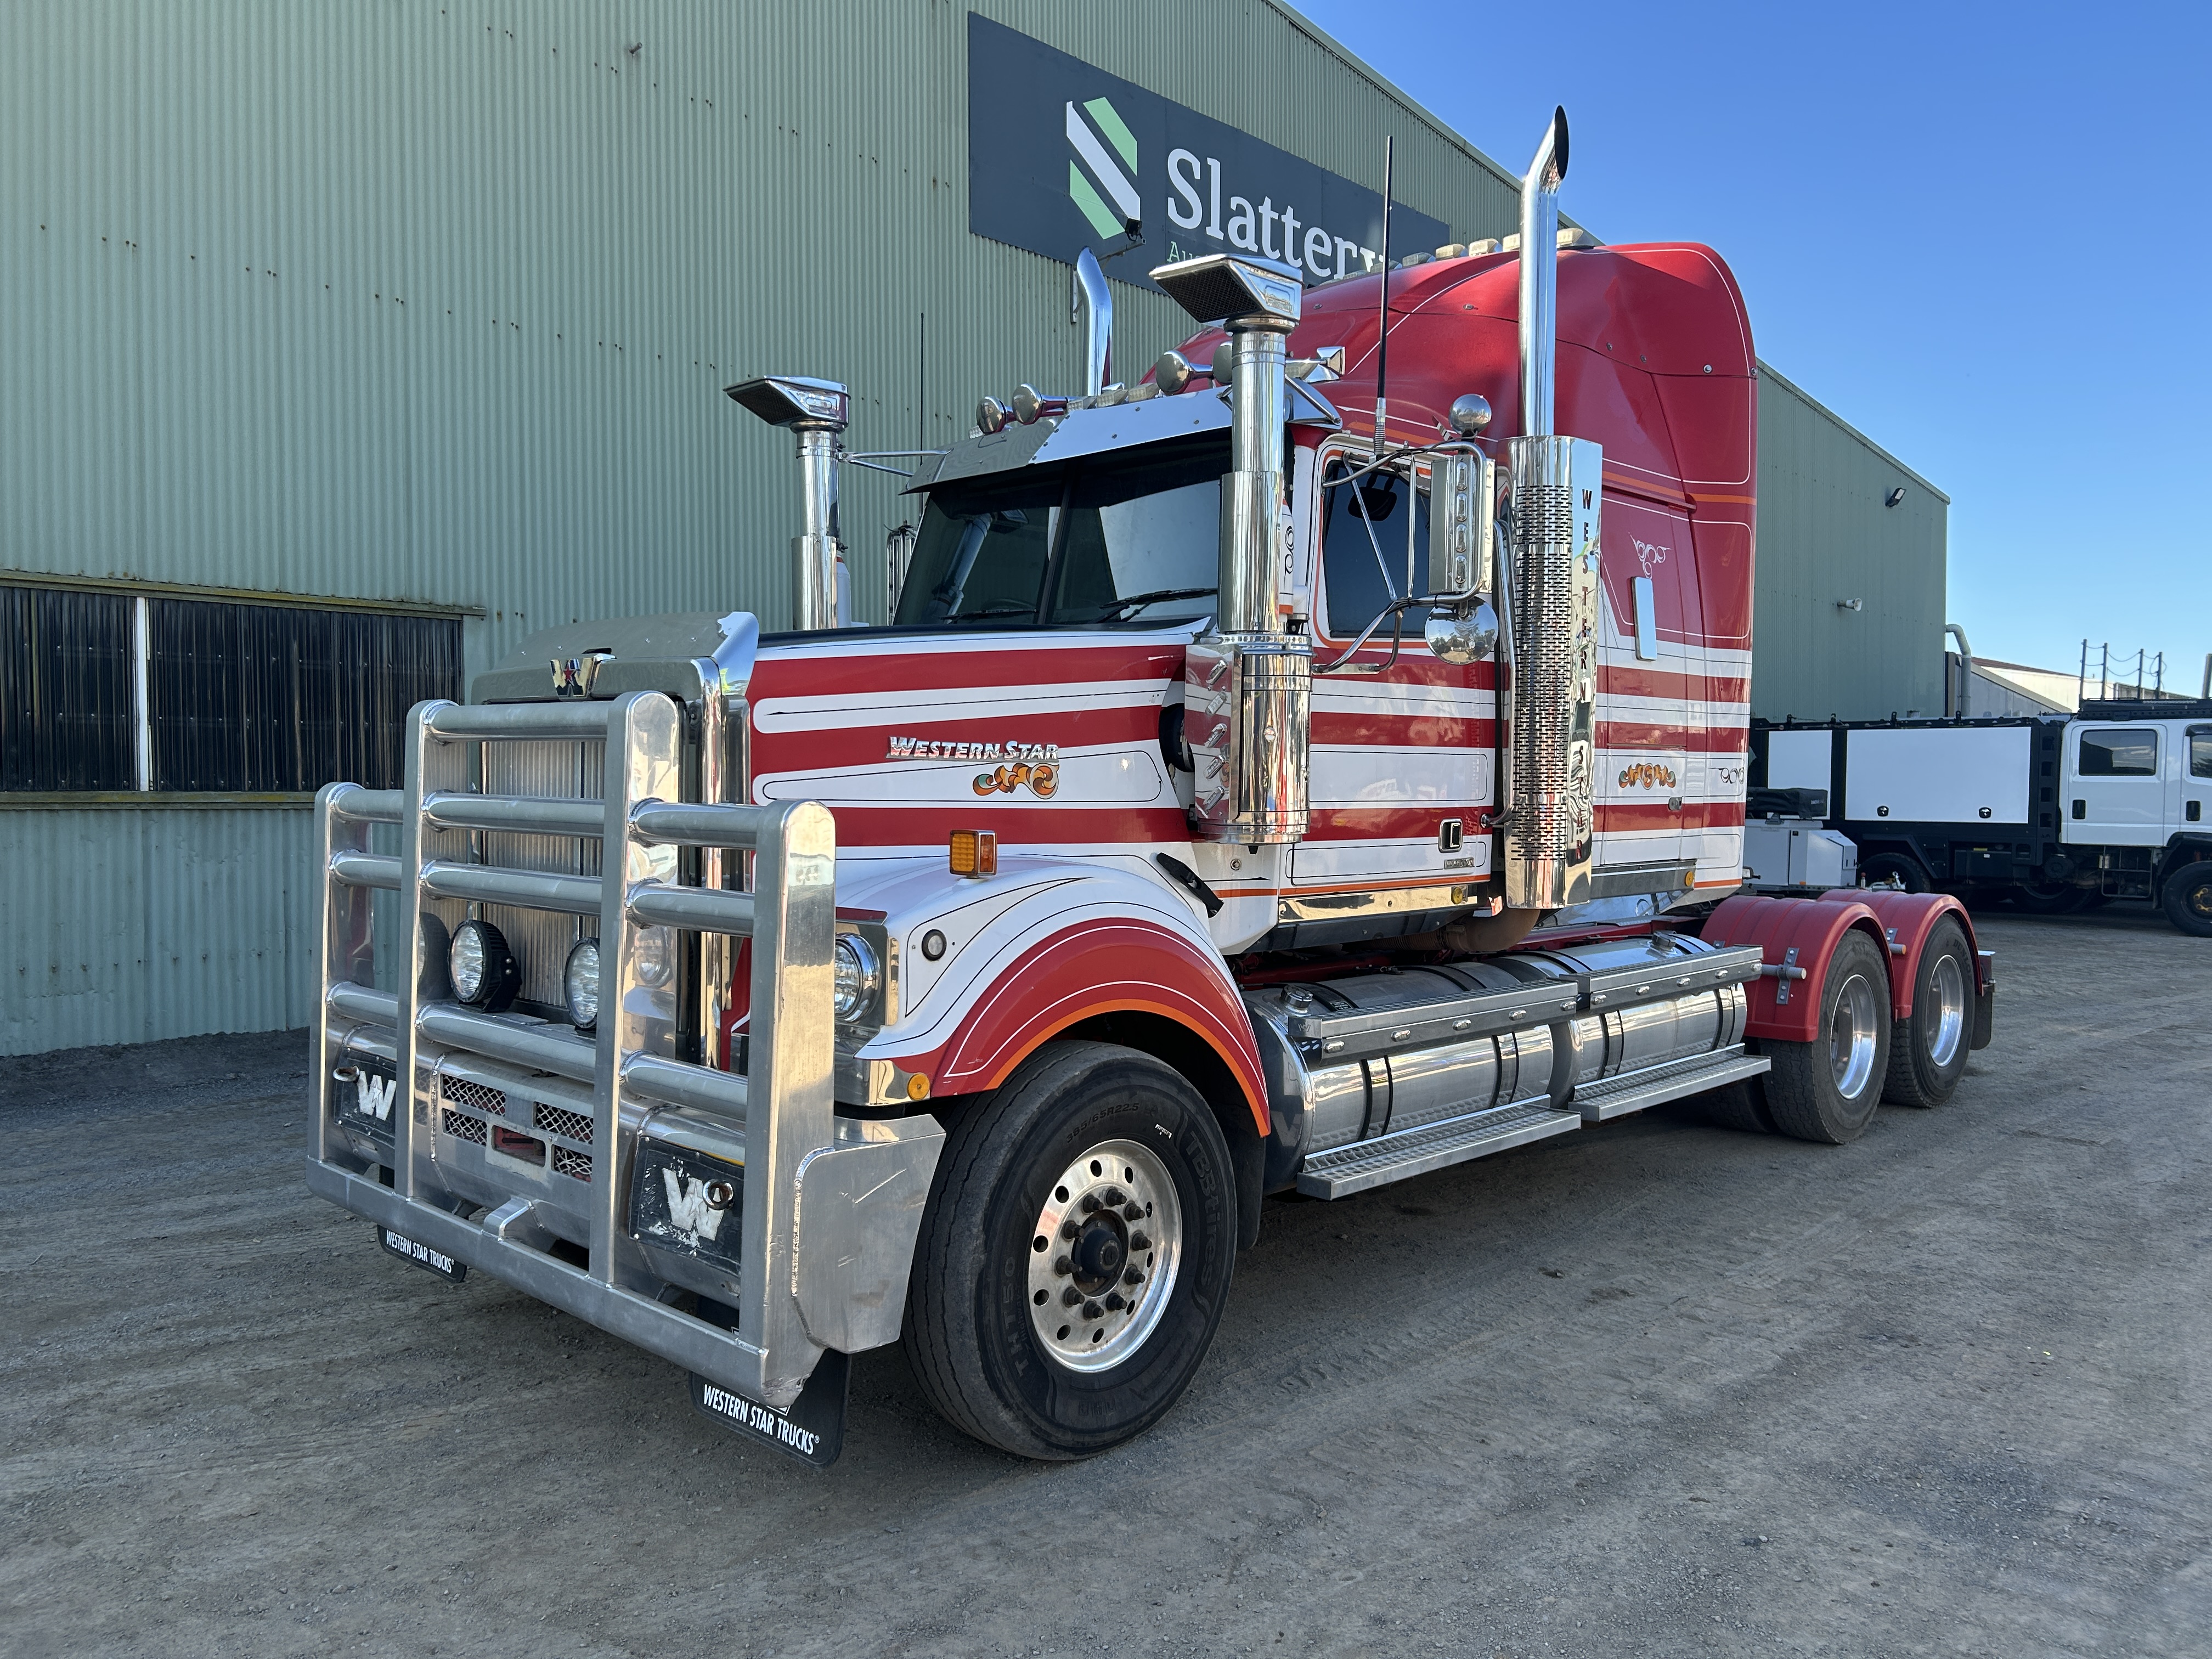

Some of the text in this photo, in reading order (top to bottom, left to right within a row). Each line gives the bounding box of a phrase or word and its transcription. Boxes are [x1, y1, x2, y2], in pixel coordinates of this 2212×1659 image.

[1066, 1102, 1139, 1144] 385/65R22.5
[386, 1229, 411, 1255] WESTERN
[413, 1242, 428, 1262] STAR
[703, 1384, 749, 1423] WESTERN
[749, 1405, 775, 1436] STAR
